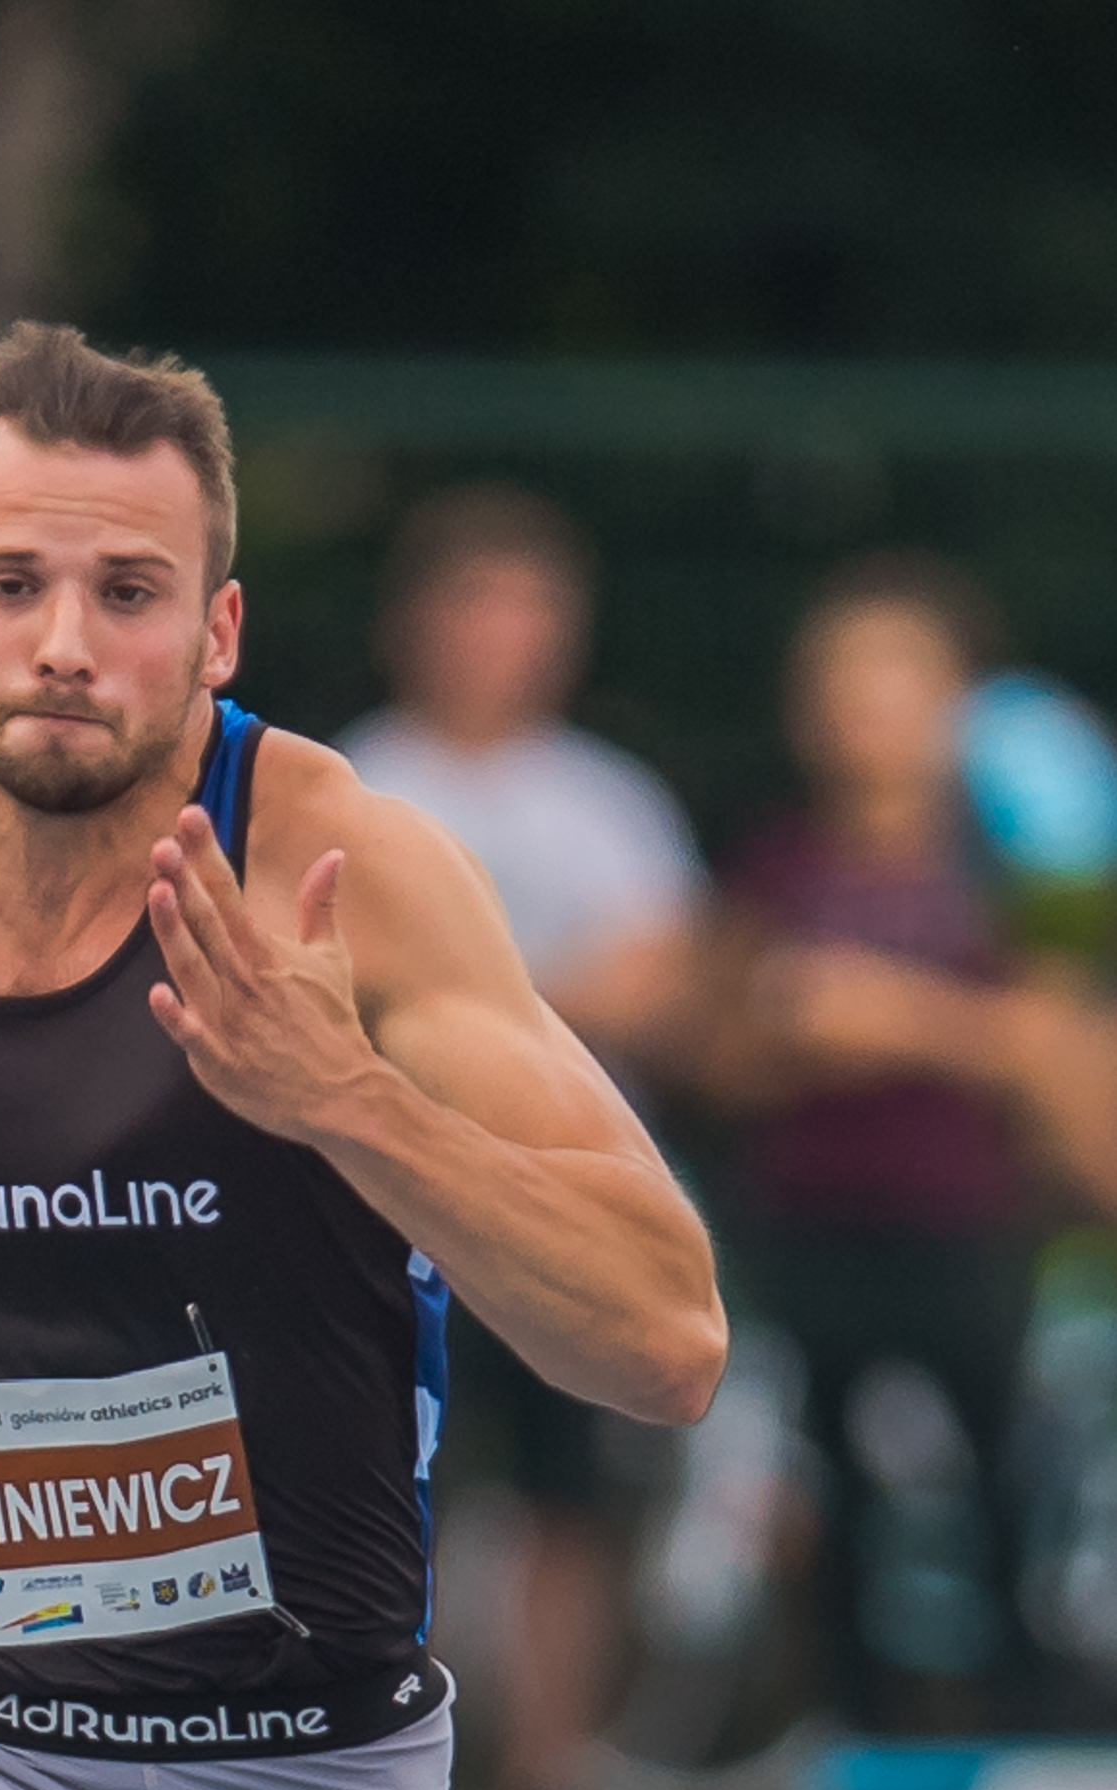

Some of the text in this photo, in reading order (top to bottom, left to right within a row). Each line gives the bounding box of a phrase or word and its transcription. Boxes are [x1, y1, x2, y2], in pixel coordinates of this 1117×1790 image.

[10, 1408, 86, 1430] goleniów
[90, 1395, 172, 1422] athletics
[178, 1382, 224, 1407] park
